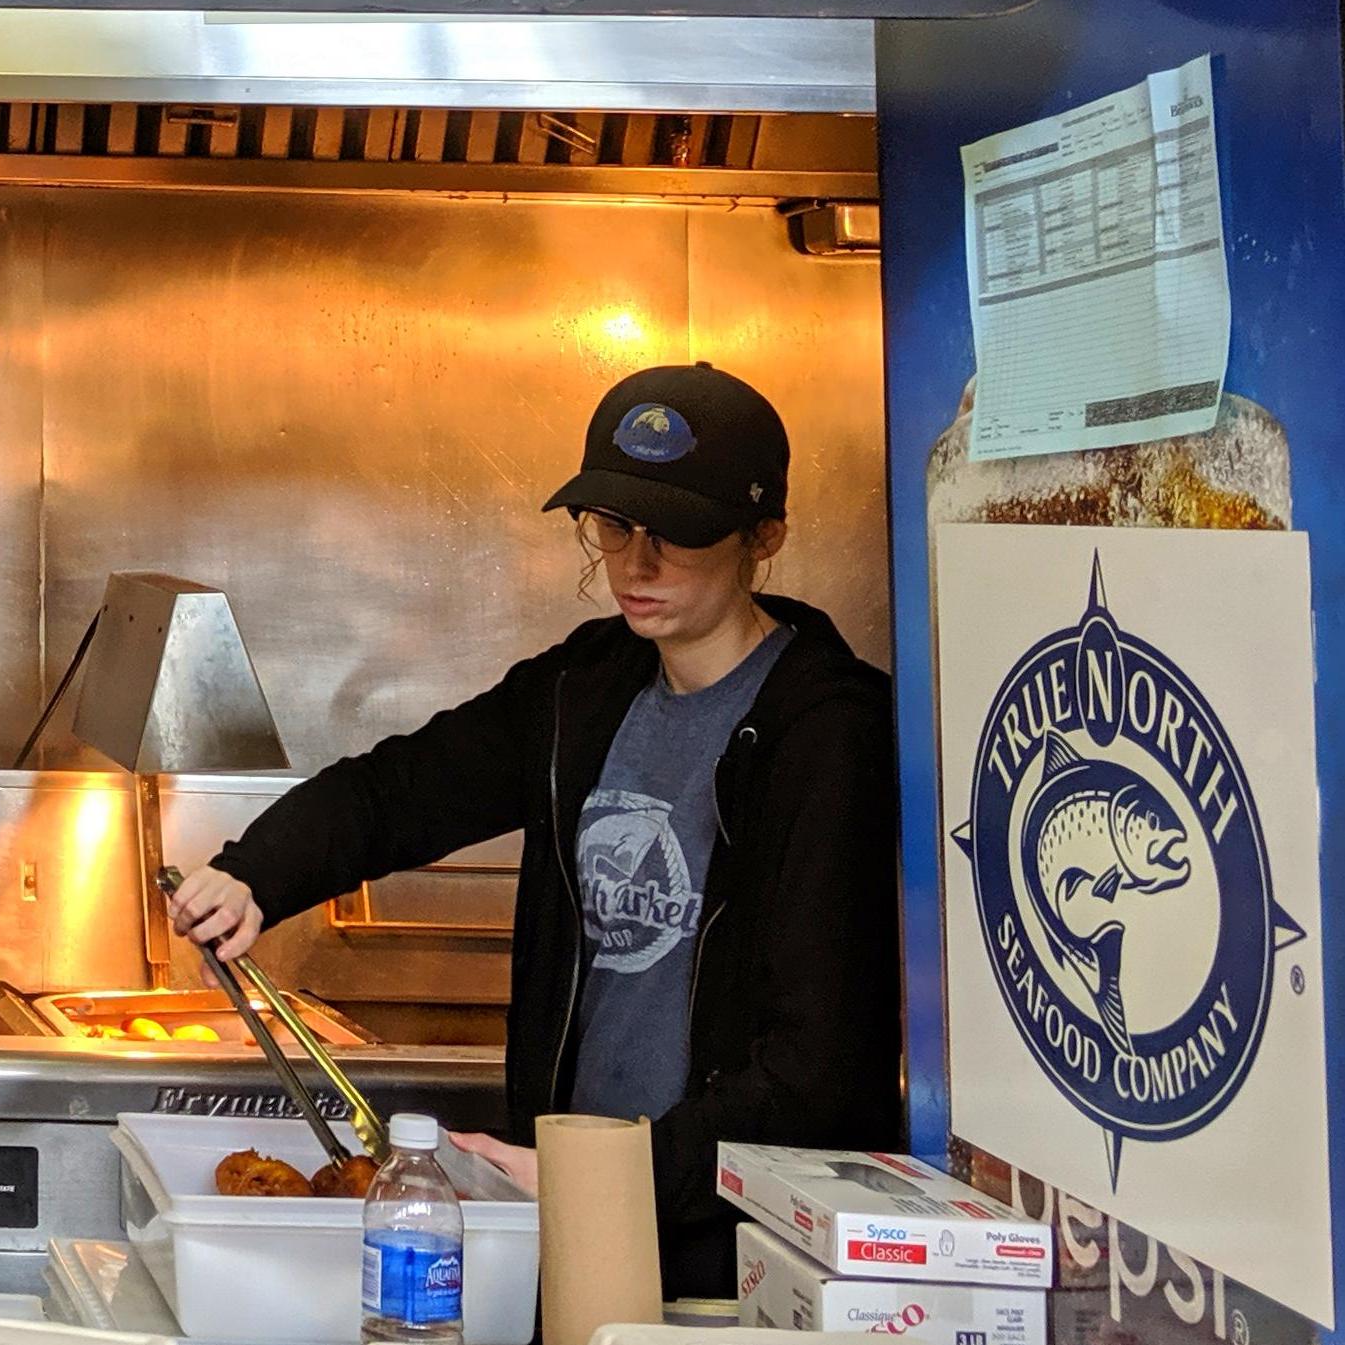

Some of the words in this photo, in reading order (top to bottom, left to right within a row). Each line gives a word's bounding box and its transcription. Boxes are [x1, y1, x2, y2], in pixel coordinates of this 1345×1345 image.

[986, 657, 1072, 793] TRUE
[1085, 646, 1238, 845] NORTH
[996, 912, 1103, 1084] SEAFOOD
[1112, 981, 1240, 1105] COMPANY
[867, 1224, 906, 1241] Sysco
[986, 1231, 1006, 1243] Poly
[1008, 1233, 1041, 1244] Gloves
[860, 1242, 914, 1263] Classic
